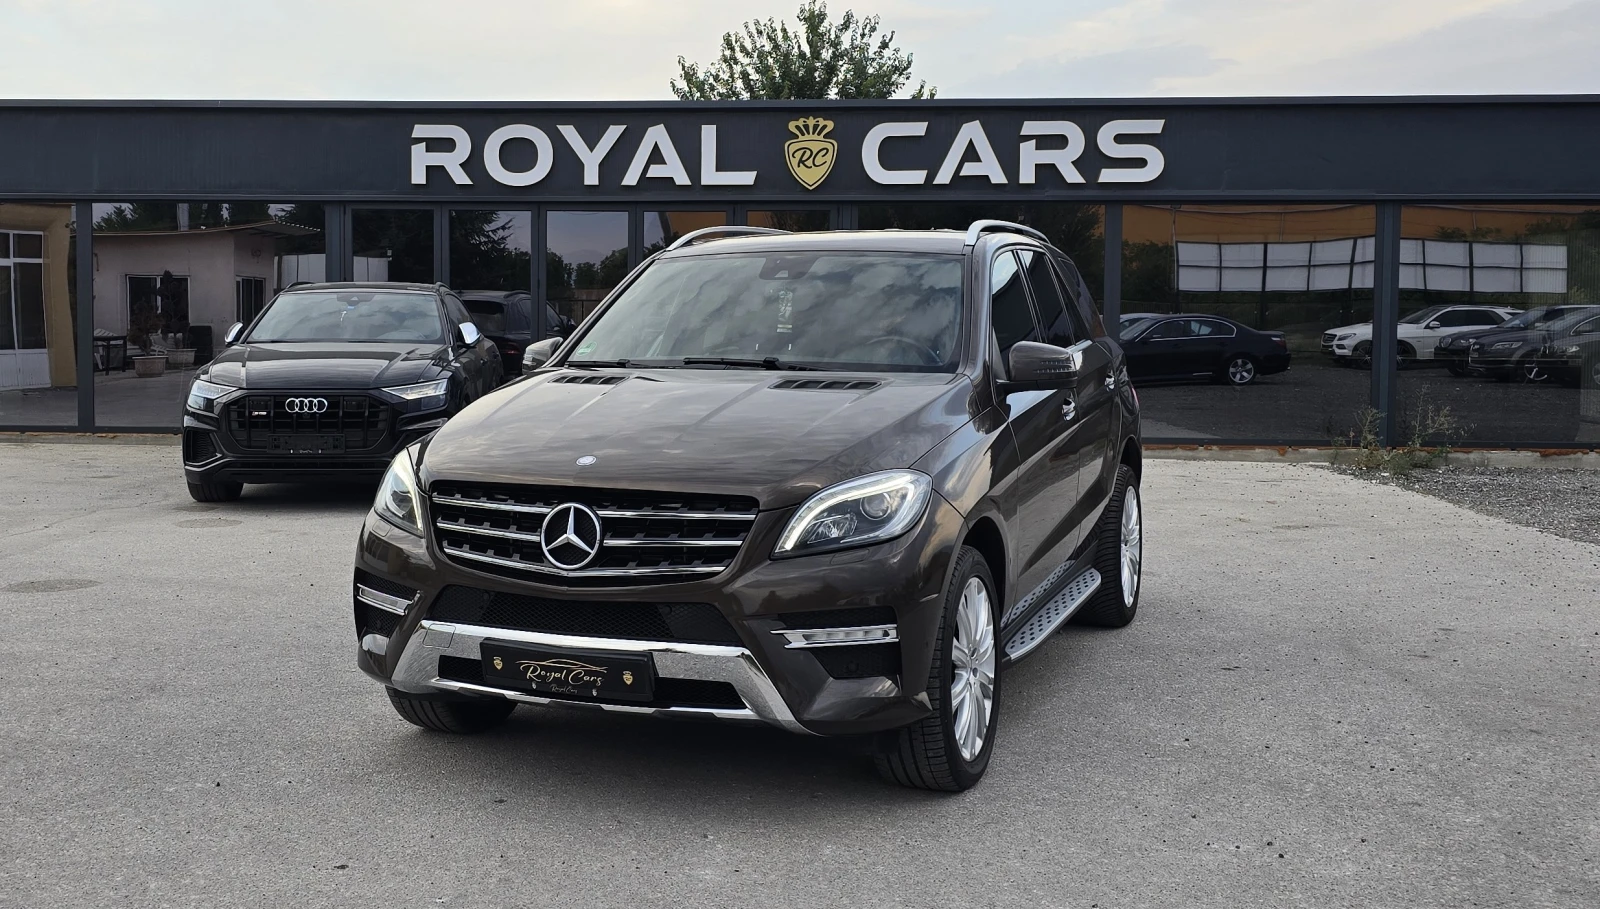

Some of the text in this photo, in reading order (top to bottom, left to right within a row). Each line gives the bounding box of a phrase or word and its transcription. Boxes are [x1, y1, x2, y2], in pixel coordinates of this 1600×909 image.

[410, 119, 1166, 187] ROYAL RC CARS
[520, 663, 604, 687] Royal Cars
